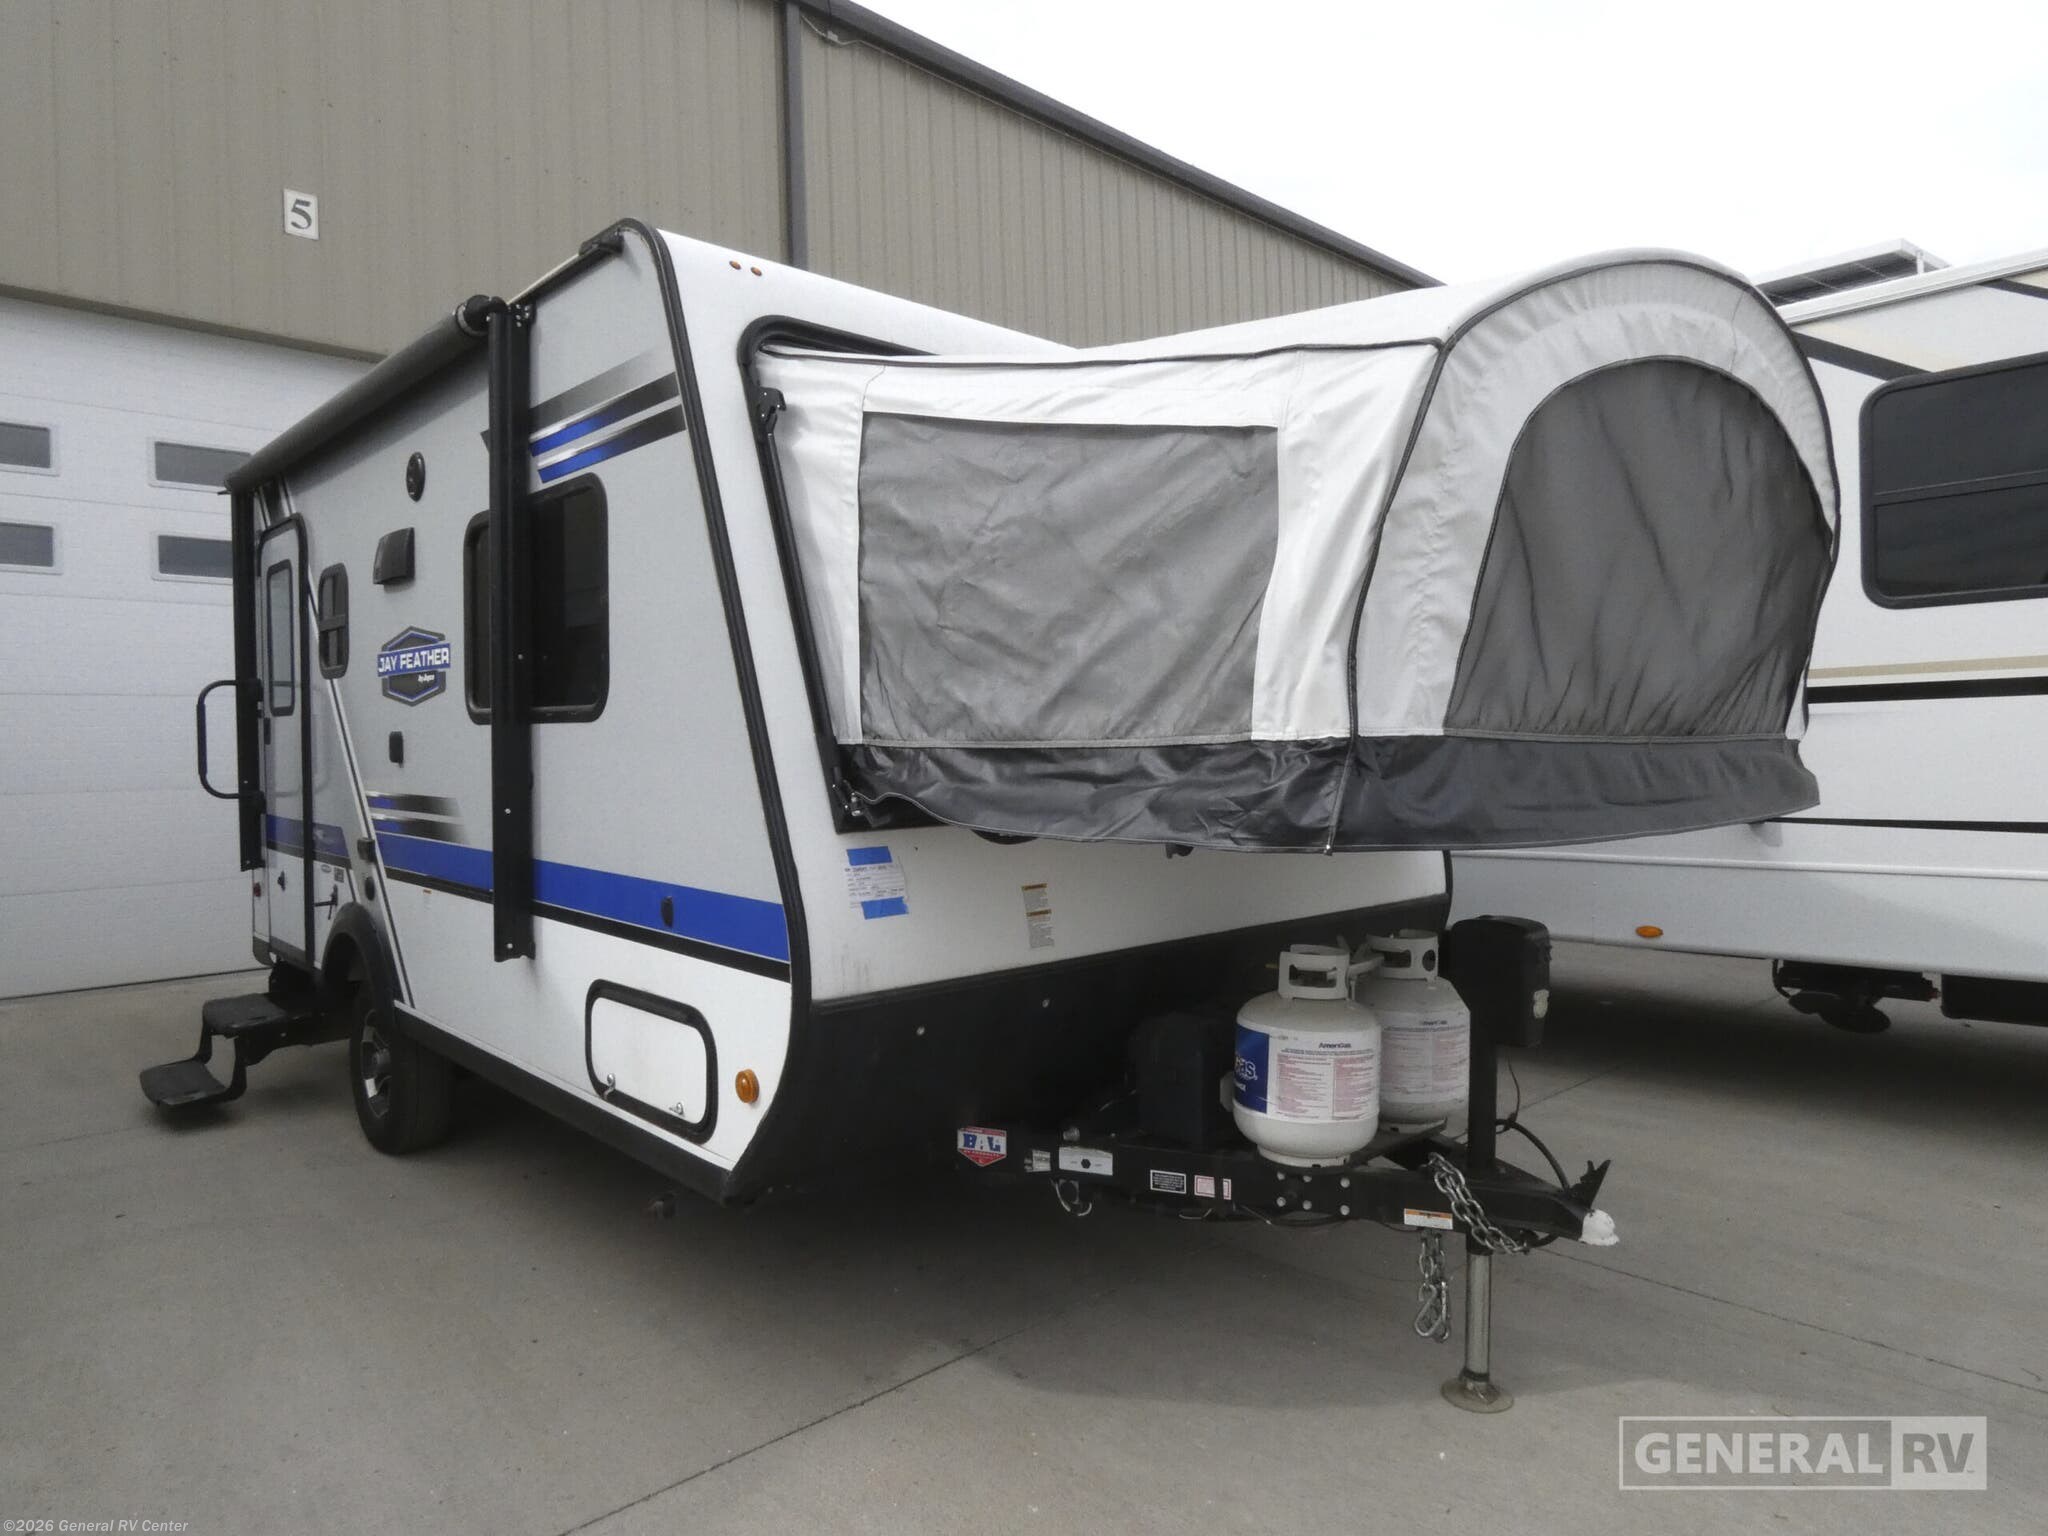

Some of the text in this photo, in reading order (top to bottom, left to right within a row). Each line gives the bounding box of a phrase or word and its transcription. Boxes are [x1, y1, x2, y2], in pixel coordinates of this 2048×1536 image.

[291, 198, 312, 230] 5
[378, 647, 449, 673] JAY FEATHER
